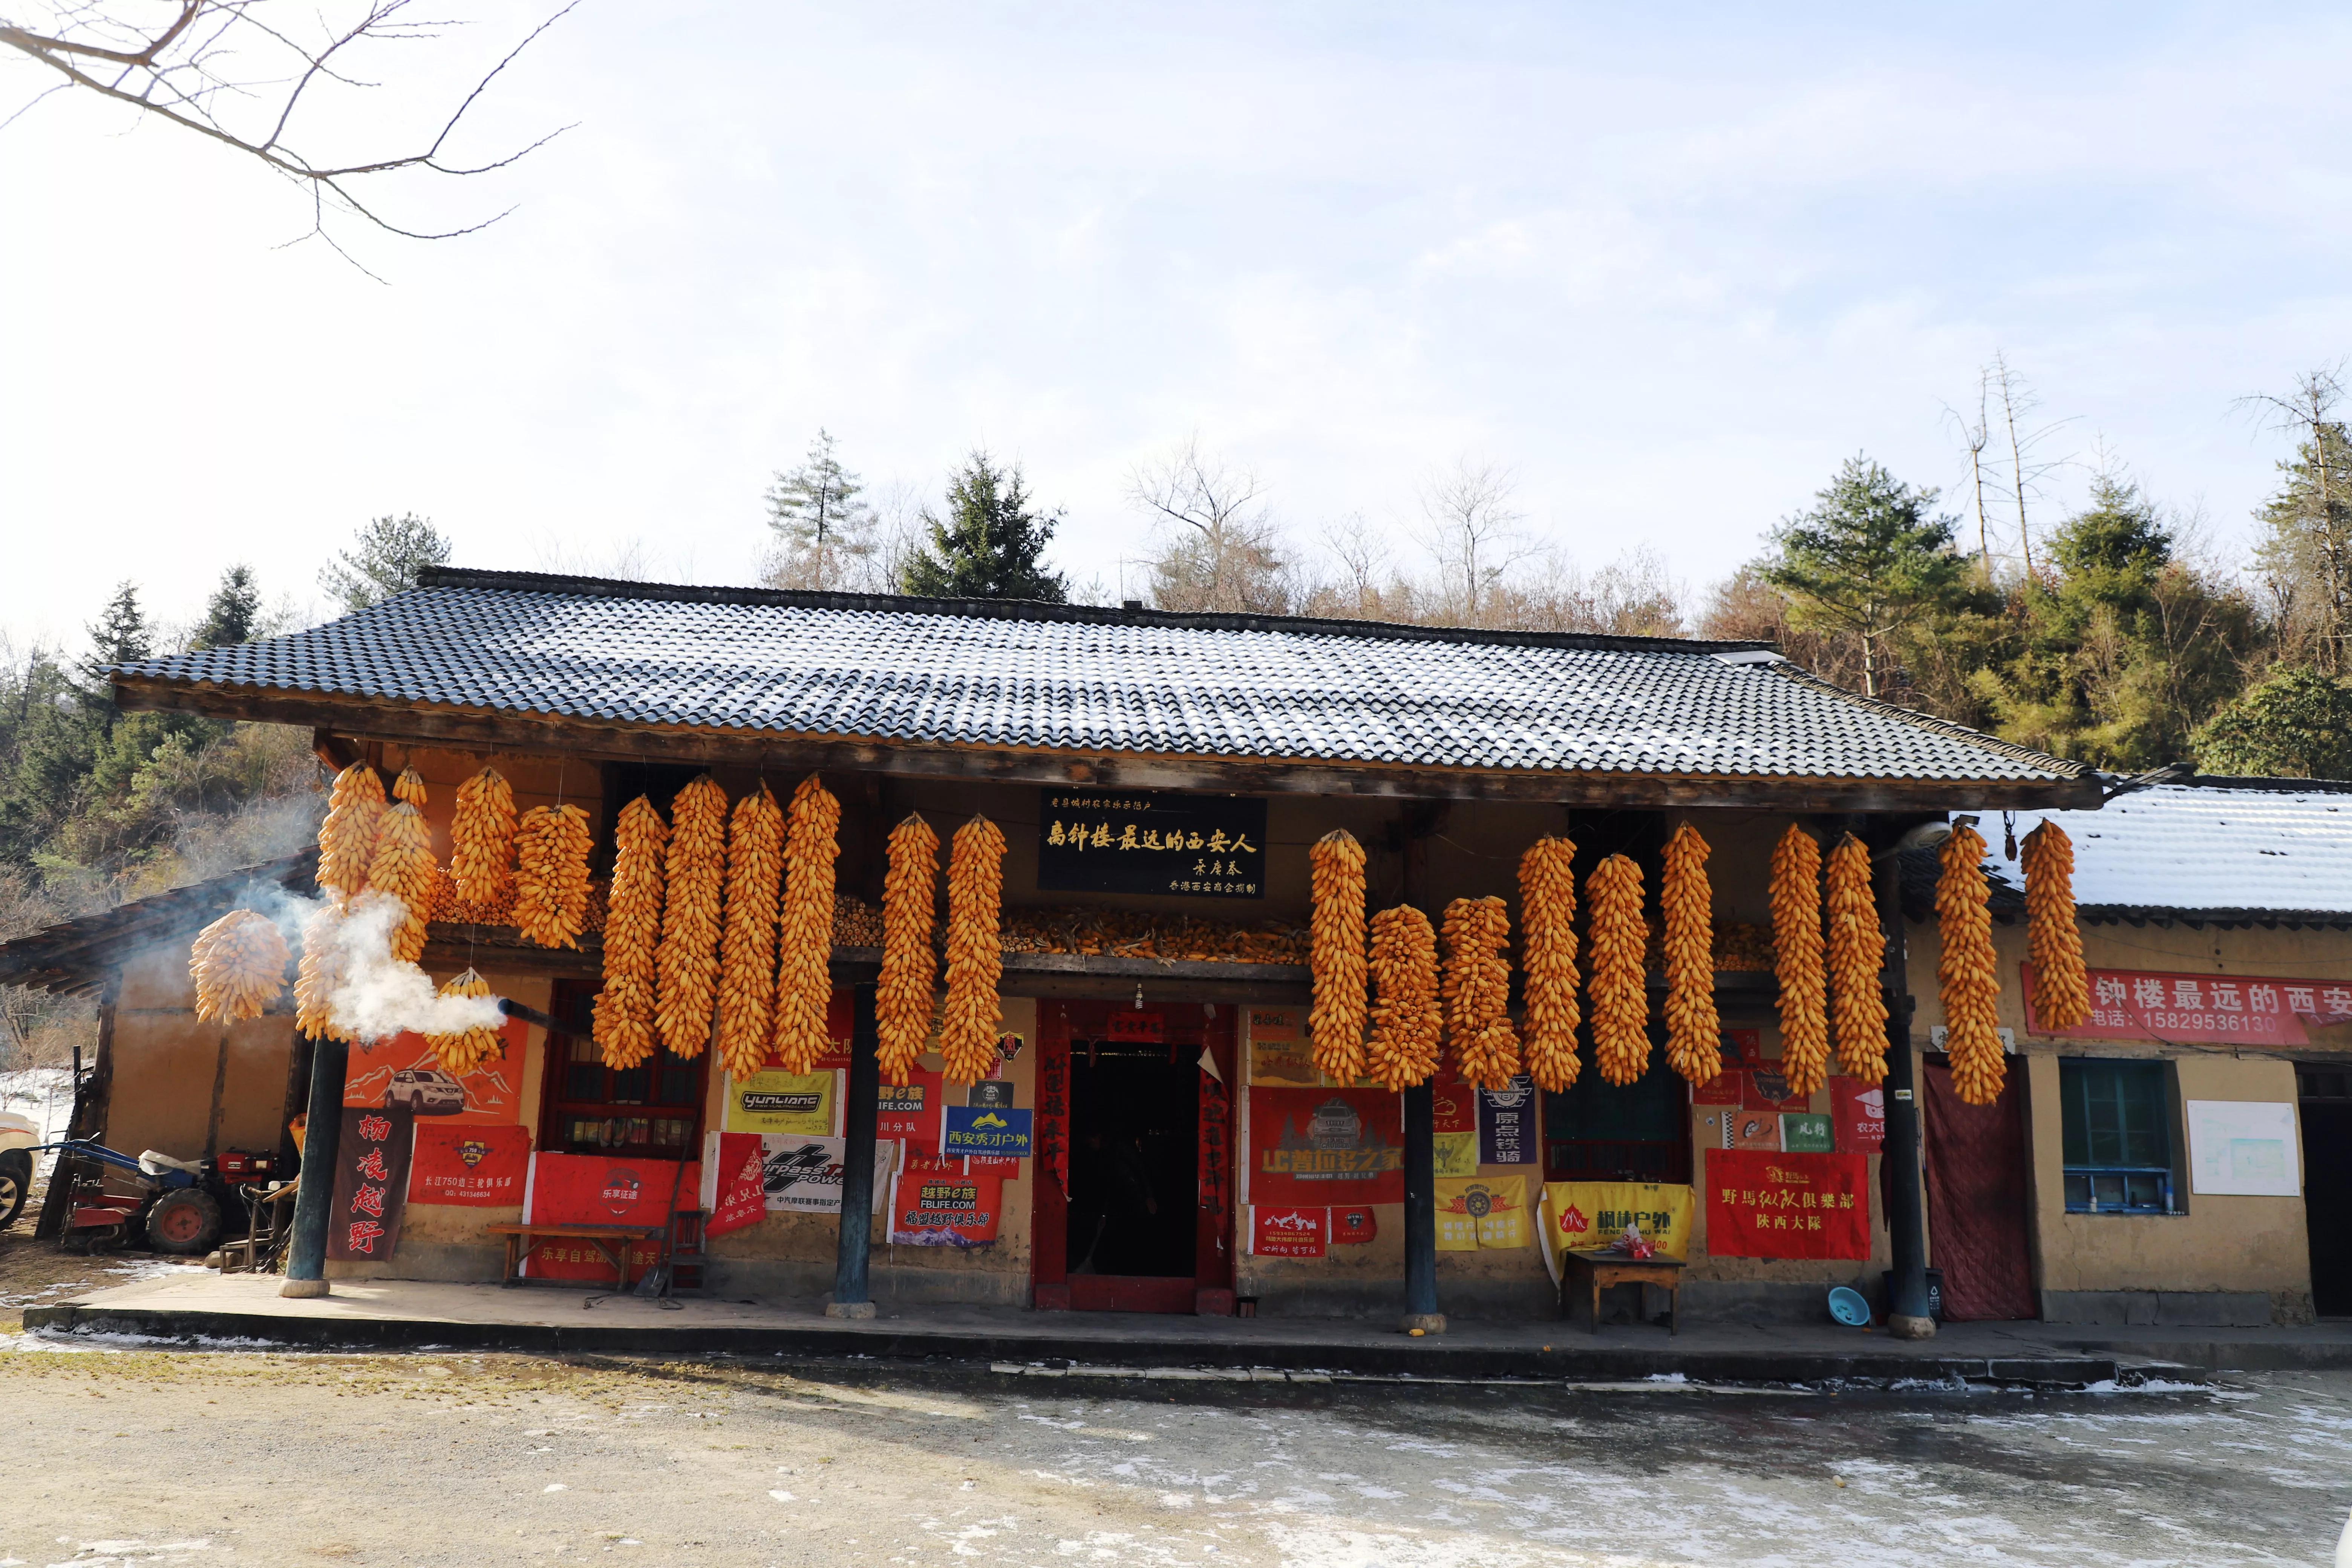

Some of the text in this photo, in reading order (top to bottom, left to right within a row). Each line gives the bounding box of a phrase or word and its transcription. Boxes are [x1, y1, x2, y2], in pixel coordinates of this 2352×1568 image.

[1047, 820, 1257, 853] 离钟楼最远的西安人
[2146, 1012, 2276, 1033] 15829536130
[877, 1102, 922, 1110] IFE.COM
[948, 1131, 1028, 1147] 西安秀才户外
[1495, 1112, 1521, 1162] 原点铁骑
[763, 1164, 824, 1175] urpass
[349, 1115, 392, 1254] 杨凌越野
[425, 1176, 511, 1188] 长江750边三轮俱乐部
[602, 1189, 638, 1200] 乐享征途
[921, 1186, 977, 1200] 越野e族
[920, 1200, 975, 1209] FBLIFE.COM
[905, 1210, 989, 1227] 福盟越野俱乐部
[1597, 1210, 1671, 1229] 枫林户外
